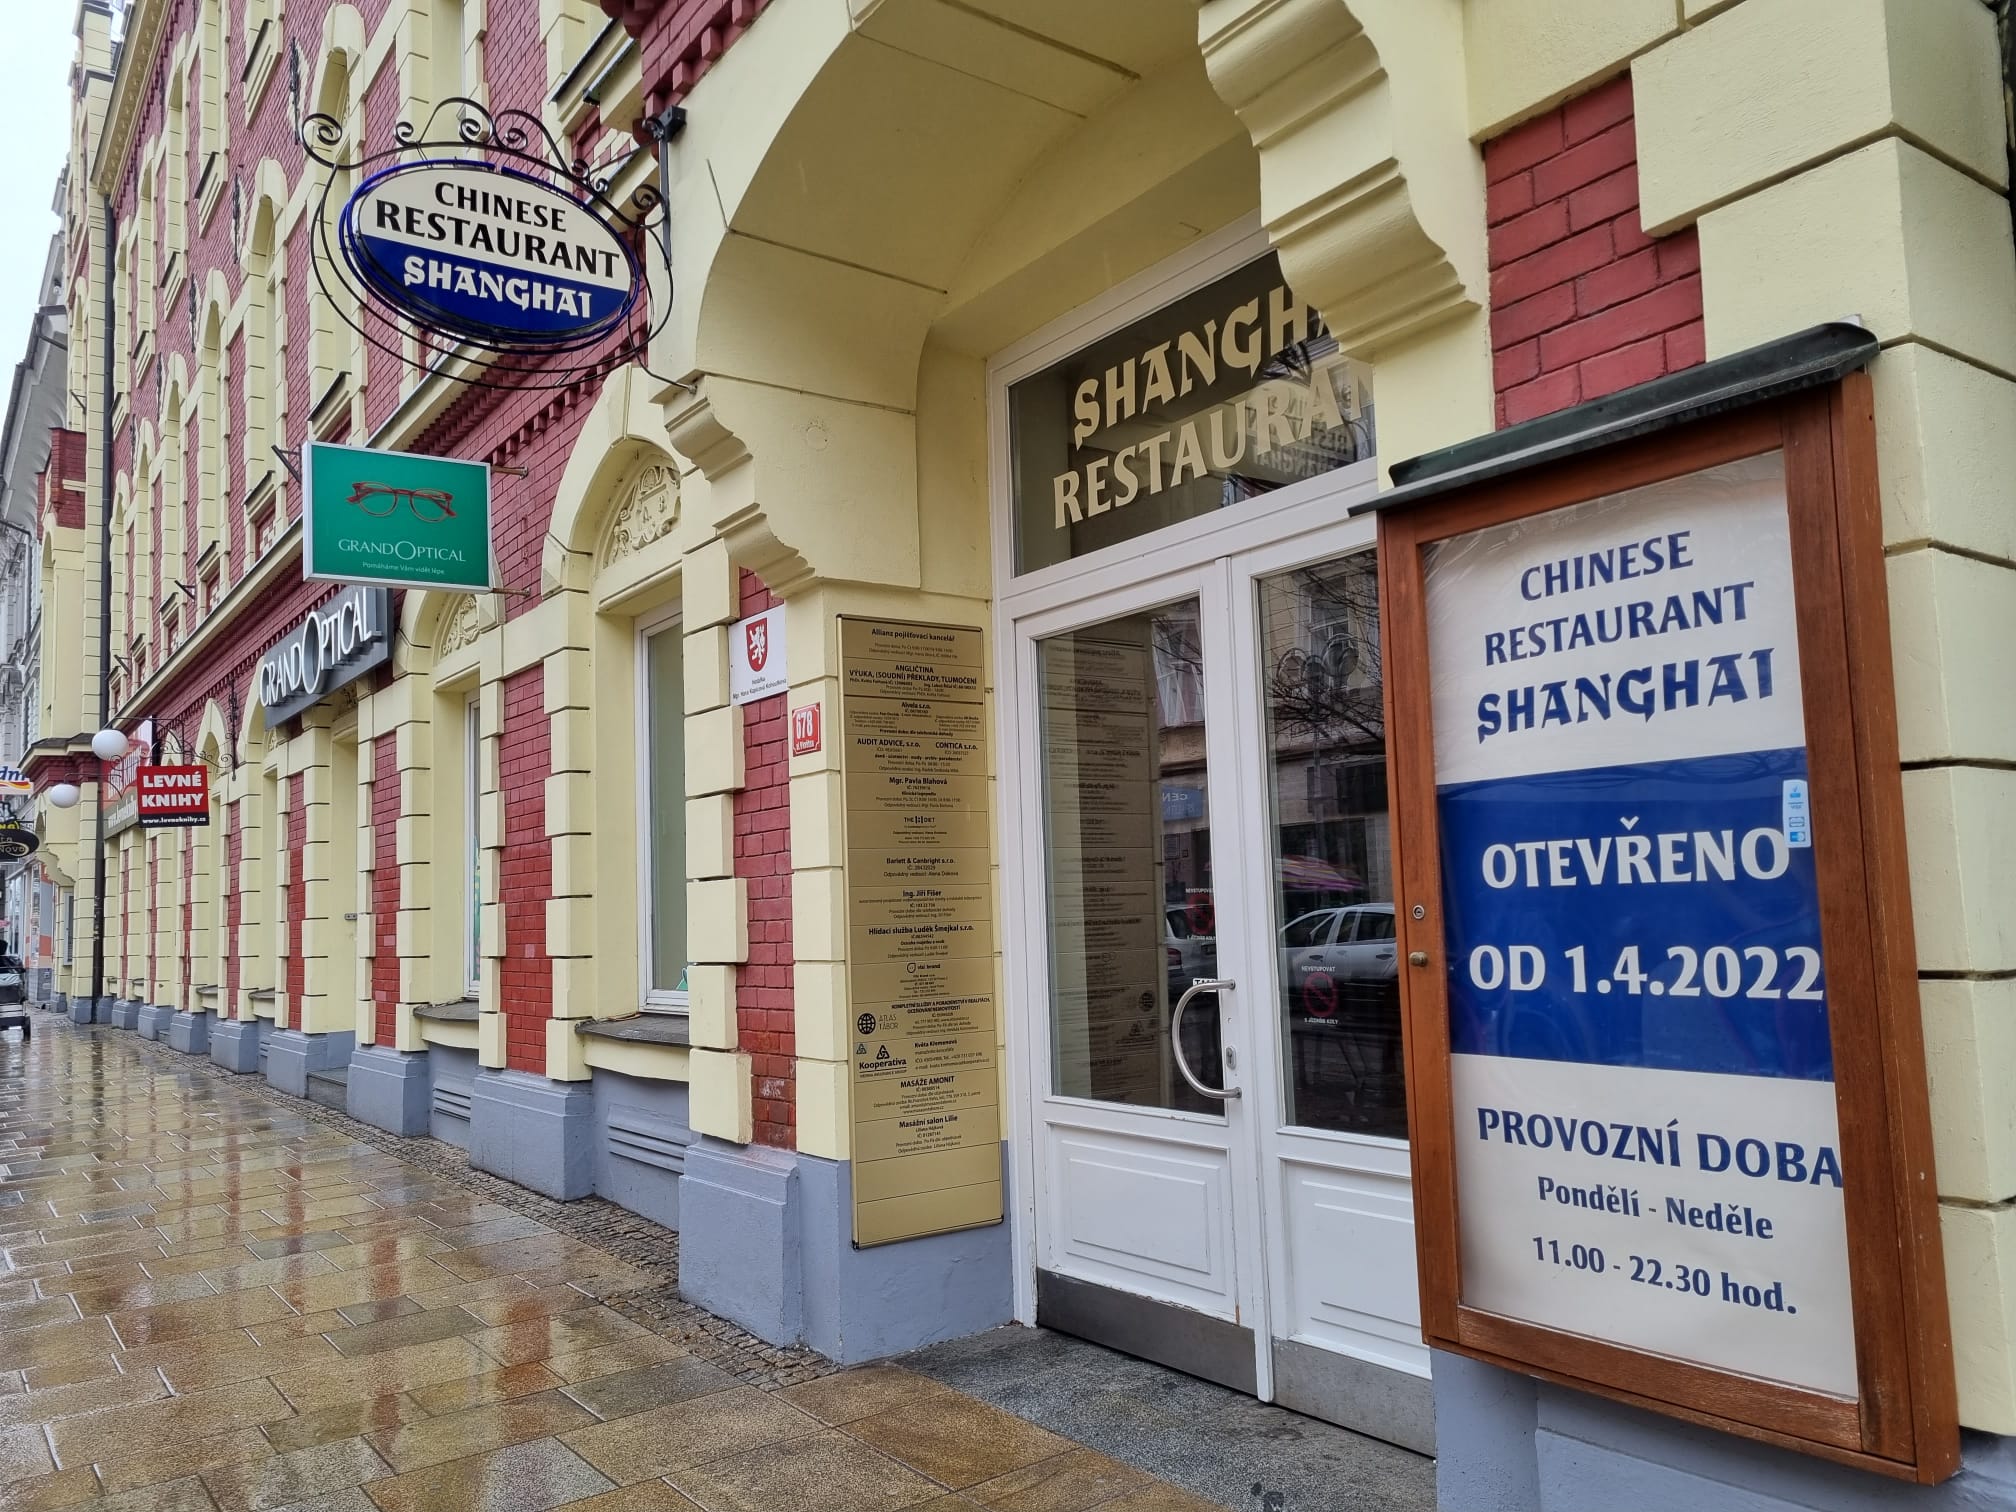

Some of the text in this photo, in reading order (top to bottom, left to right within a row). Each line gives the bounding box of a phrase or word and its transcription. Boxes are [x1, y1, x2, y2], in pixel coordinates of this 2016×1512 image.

[434, 181, 567, 233] CHINESE
[376, 199, 620, 279] RESTAURANT
[404, 256, 592, 319] SHANGHAI
[1520, 530, 1694, 601] CHINESE
[1485, 581, 1754, 666] RESTAURANT
[871, 628, 894, 637] Allianz
[895, 664, 934, 673] ANGLIČTINA
[849, 669, 875, 678] VÝUKA,
[941, 675, 977, 685] TLUMOČENÍ
[1477, 647, 1775, 744] SHANGHAI
[796, 710, 813, 740] 678
[857, 737, 878, 746] AUDIT
[935, 741, 963, 750] CONTICA
[143, 770, 202, 788] LEVNÉ
[889, 776, 948, 786] Mgr. Pavla Blahová
[142, 793, 204, 808] KNIHY
[1482, 815, 1790, 889] OTEVŘENO
[902, 890, 916, 899] Ing.
[868, 927, 892, 936] Hlídací
[892, 926, 913, 935] služba
[914, 925, 933, 933] Luděk
[934, 924, 959, 933] Šmejkal
[1469, 944, 1824, 1001] OD 1.4.2022
[880, 1014, 897, 1022] ATLAS
[914, 1041, 930, 1049] Květa
[859, 1057, 907, 1071] Kooperativa
[900, 1078, 928, 1089] MASÁŽE
[928, 1075, 955, 1086] AMONIT
[899, 1114, 958, 1129] Masážní salon Lilie
[1476, 1107, 1844, 1189] PROVOZNÍ DOBA
[1537, 1175, 1641, 1218] Pondělí
[1665, 1197, 1774, 1240] Neděle
[1532, 1236, 1605, 1274] 11.00
[1629, 1255, 1711, 1298] 22.30
[1720, 1271, 1798, 1315] hod.
